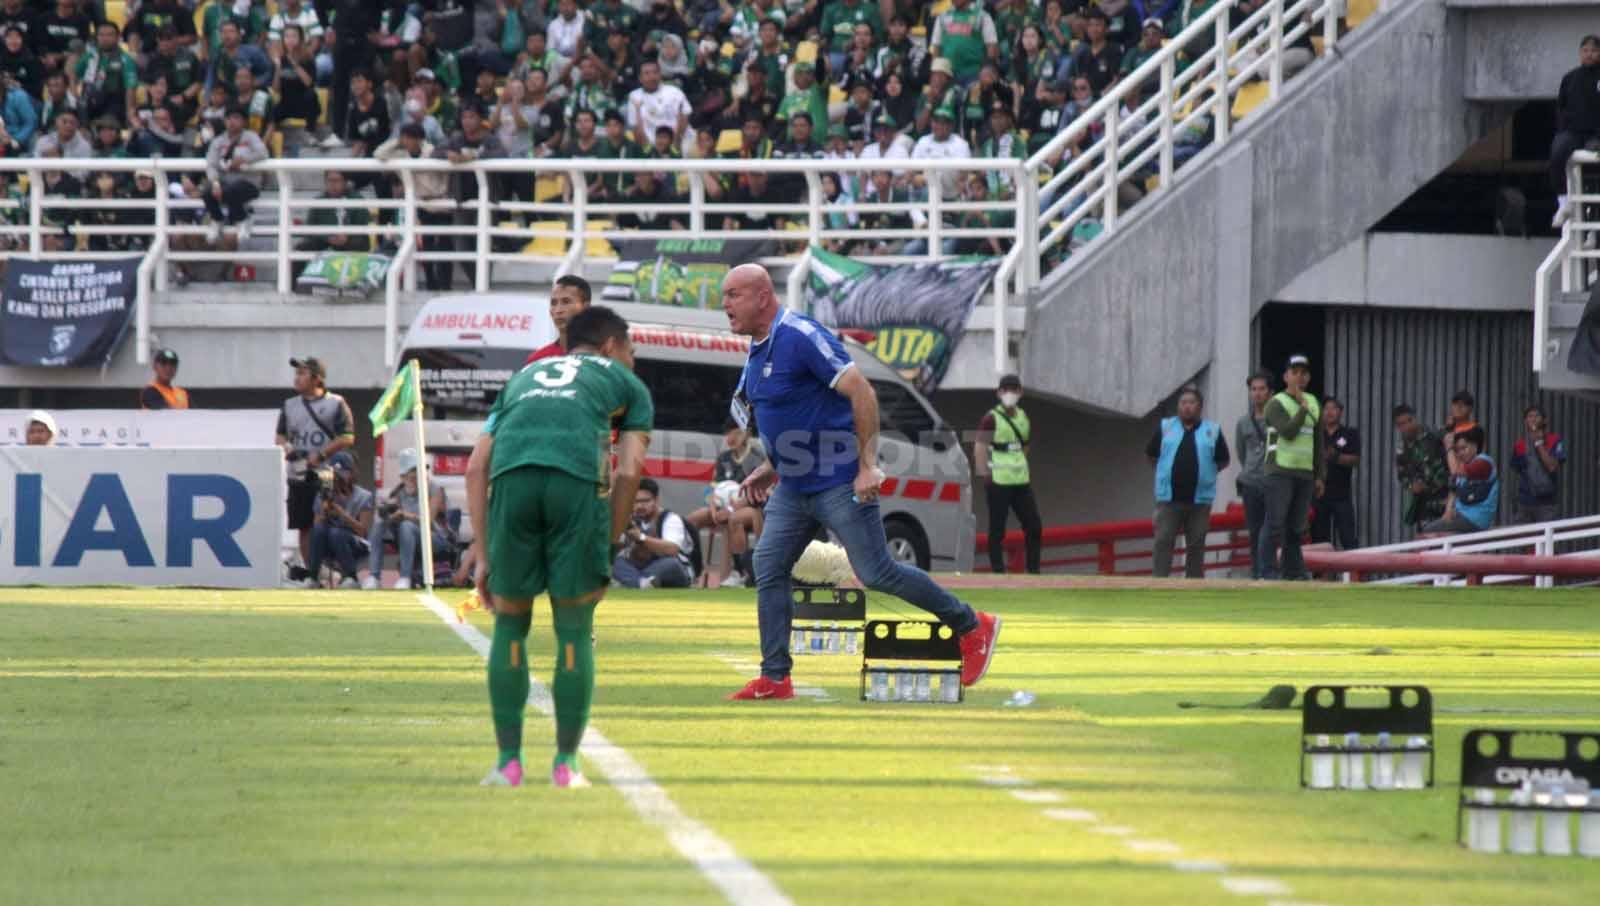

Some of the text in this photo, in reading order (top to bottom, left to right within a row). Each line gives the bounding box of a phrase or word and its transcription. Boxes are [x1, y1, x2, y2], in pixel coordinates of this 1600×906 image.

[41, 302, 64, 319] DAN
[421, 312, 534, 332] AMBULANCE
[533, 355, 582, 387] 3
[0, 472, 252, 568] IAR
